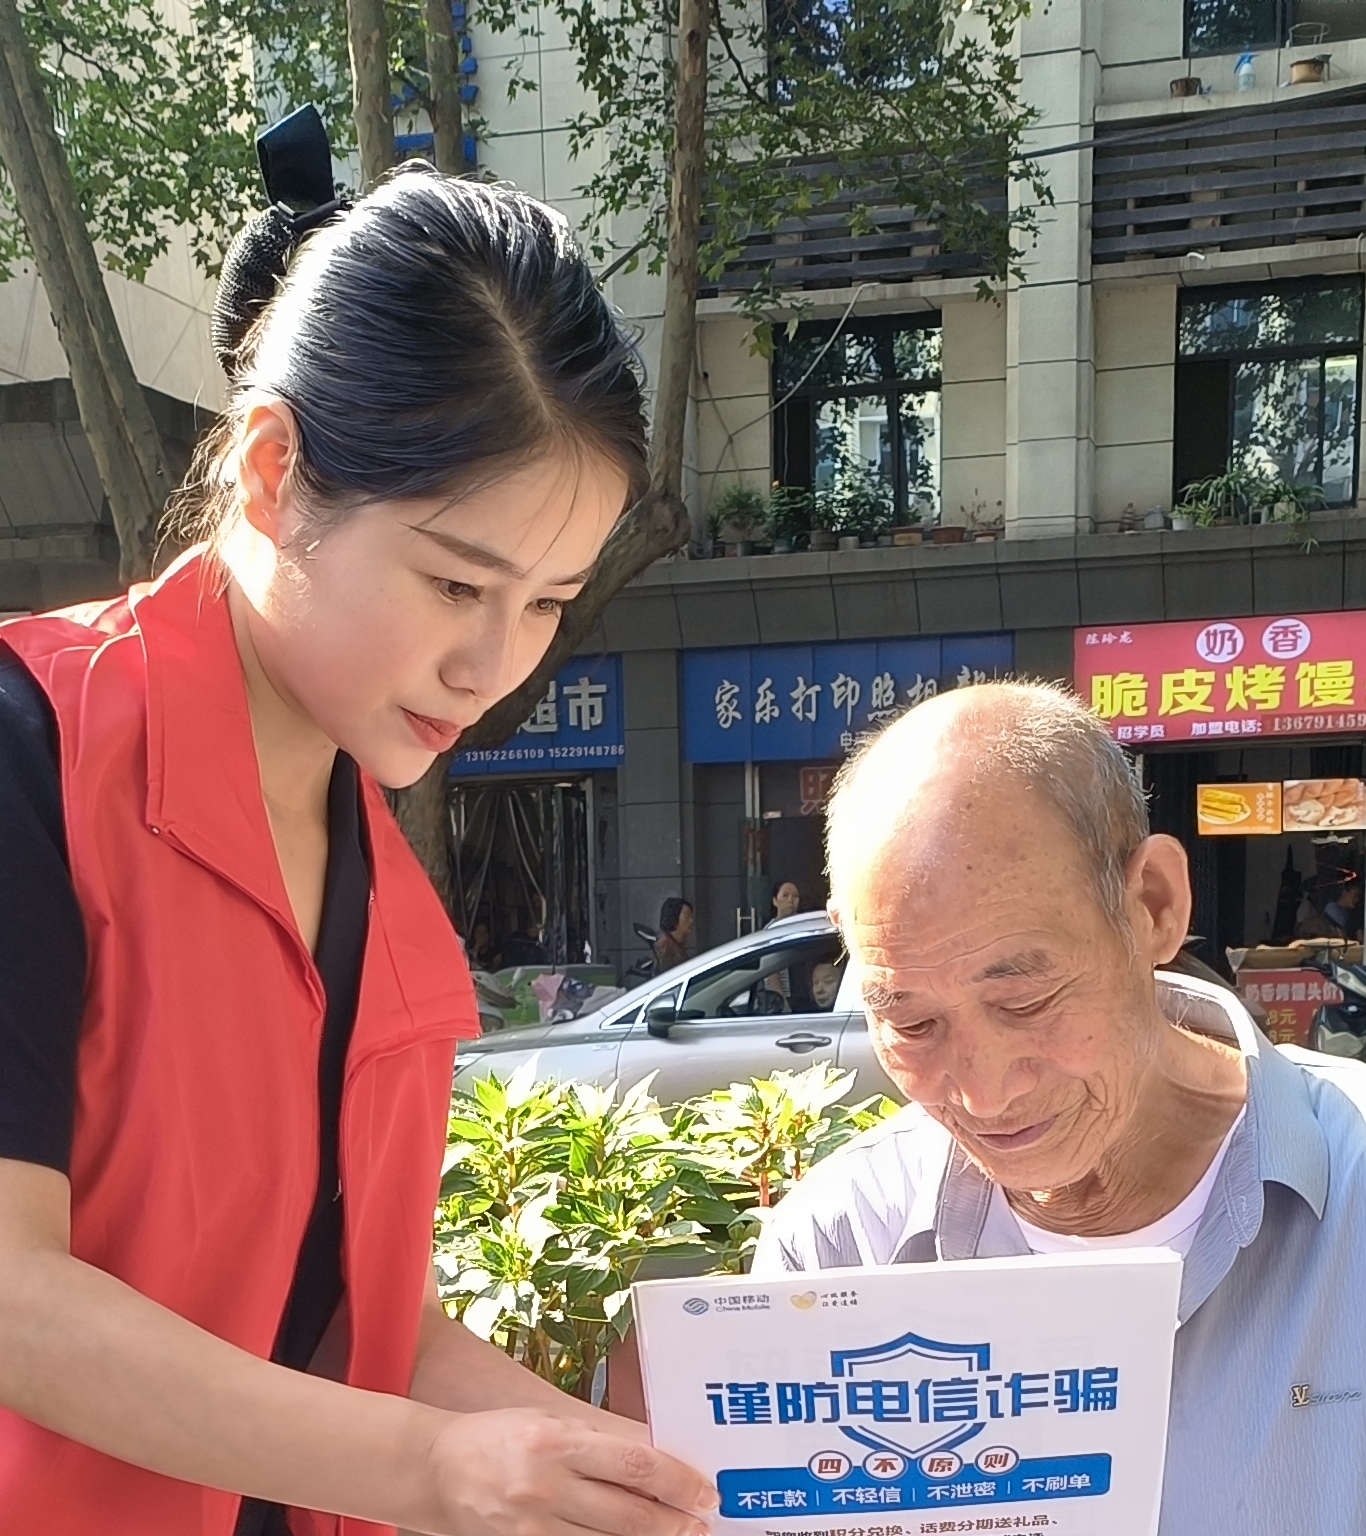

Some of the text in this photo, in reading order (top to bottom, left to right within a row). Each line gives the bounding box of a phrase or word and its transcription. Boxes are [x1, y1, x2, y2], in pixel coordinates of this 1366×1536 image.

[1204, 623, 1303, 658] 奶香
[1109, 723, 1165, 741] 招学员
[714, 1294, 770, 1305] 中国移动
[705, 1366, 1119, 1427] 谨防电信诈骗
[818, 1453, 1009, 1474] 四不原则
[737, 1474, 1092, 1509] 不汇款 不轻信 不泄密 不刷单
